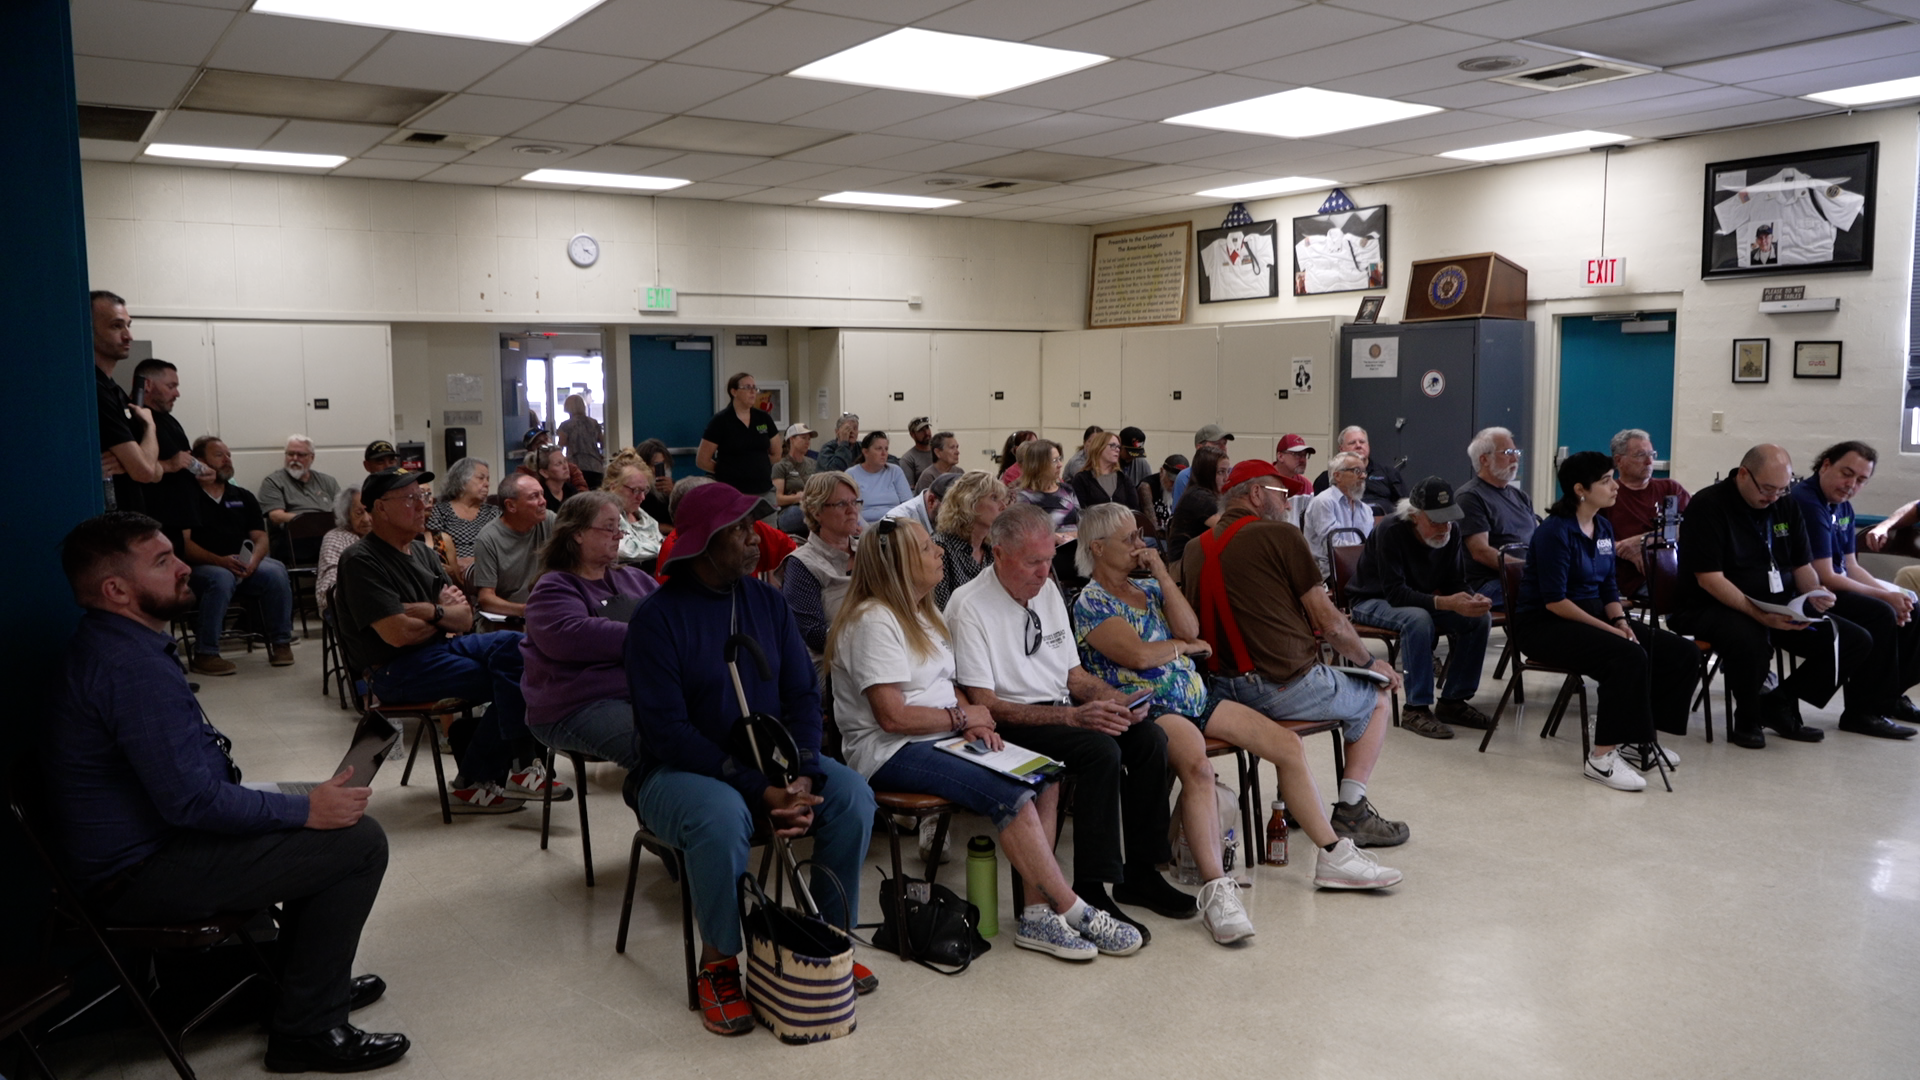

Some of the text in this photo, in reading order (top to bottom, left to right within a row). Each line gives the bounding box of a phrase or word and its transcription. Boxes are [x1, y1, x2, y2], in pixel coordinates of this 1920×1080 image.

[1143, 233, 1168, 241] Constitution
[1587, 259, 1617, 284] EXIT
[647, 288, 672, 308] EXIT
